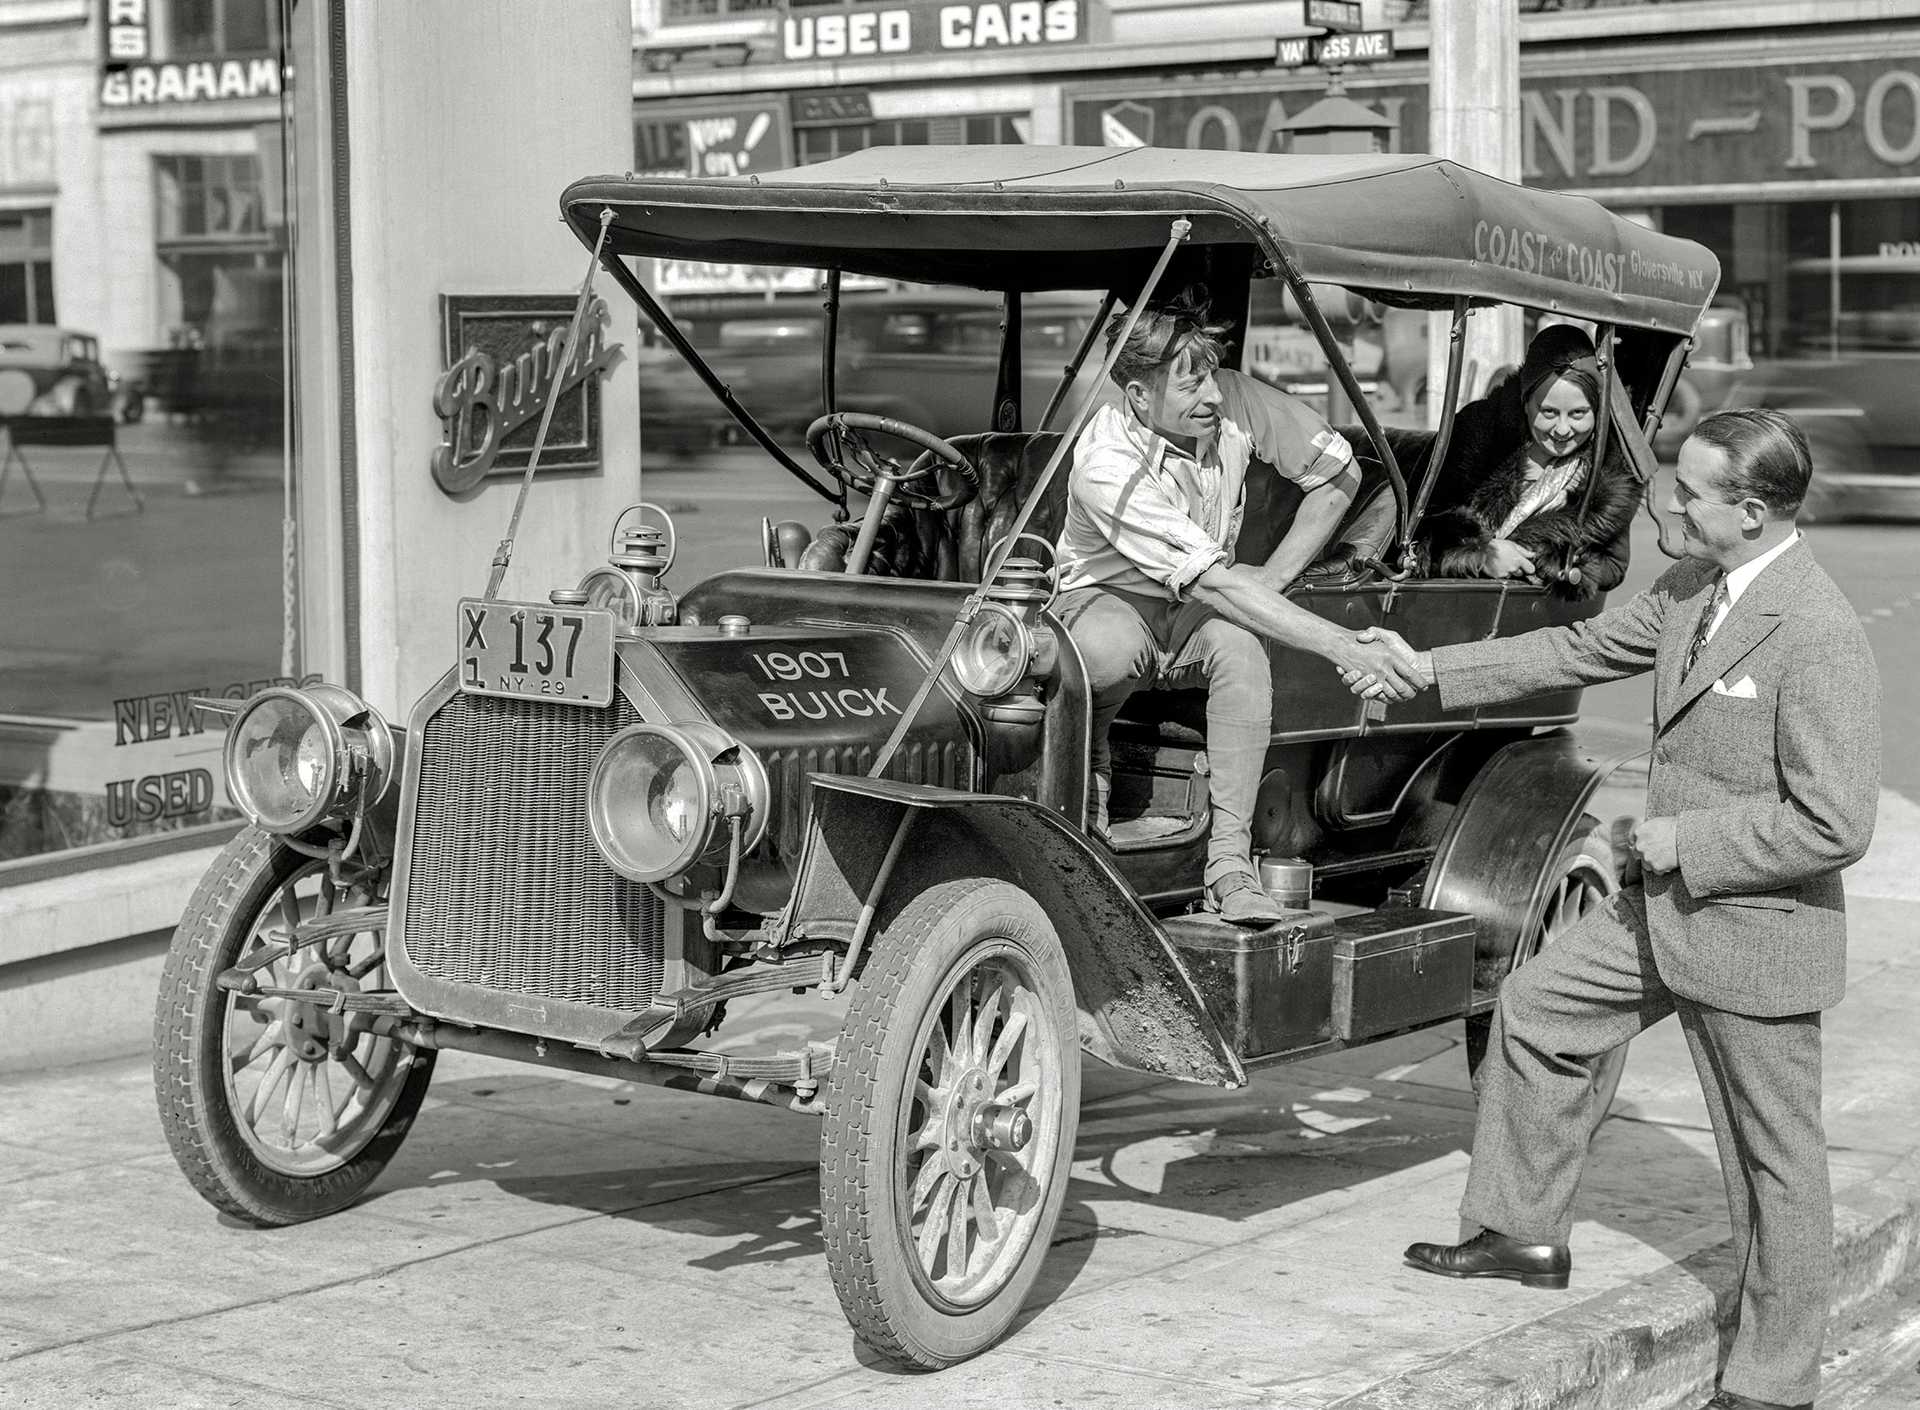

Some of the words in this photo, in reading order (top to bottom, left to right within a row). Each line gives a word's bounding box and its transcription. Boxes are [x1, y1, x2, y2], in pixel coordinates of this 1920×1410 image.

[784, 10, 911, 59] USED
[940, 0, 1077, 48] CARS
[1355, 34, 1388, 55] AVE.
[102, 59, 281, 104] GRAHAM
[1475, 220, 1548, 276] COAST
[1567, 243, 1626, 294] COAST
[1631, 248, 1684, 286] Gloversville
[464, 608, 488, 650] X
[510, 611, 583, 678] 137
[753, 652, 850, 680] 1907
[113, 687, 210, 746] NEW
[757, 687, 903, 720] BUICK
[106, 768, 214, 828] USED
